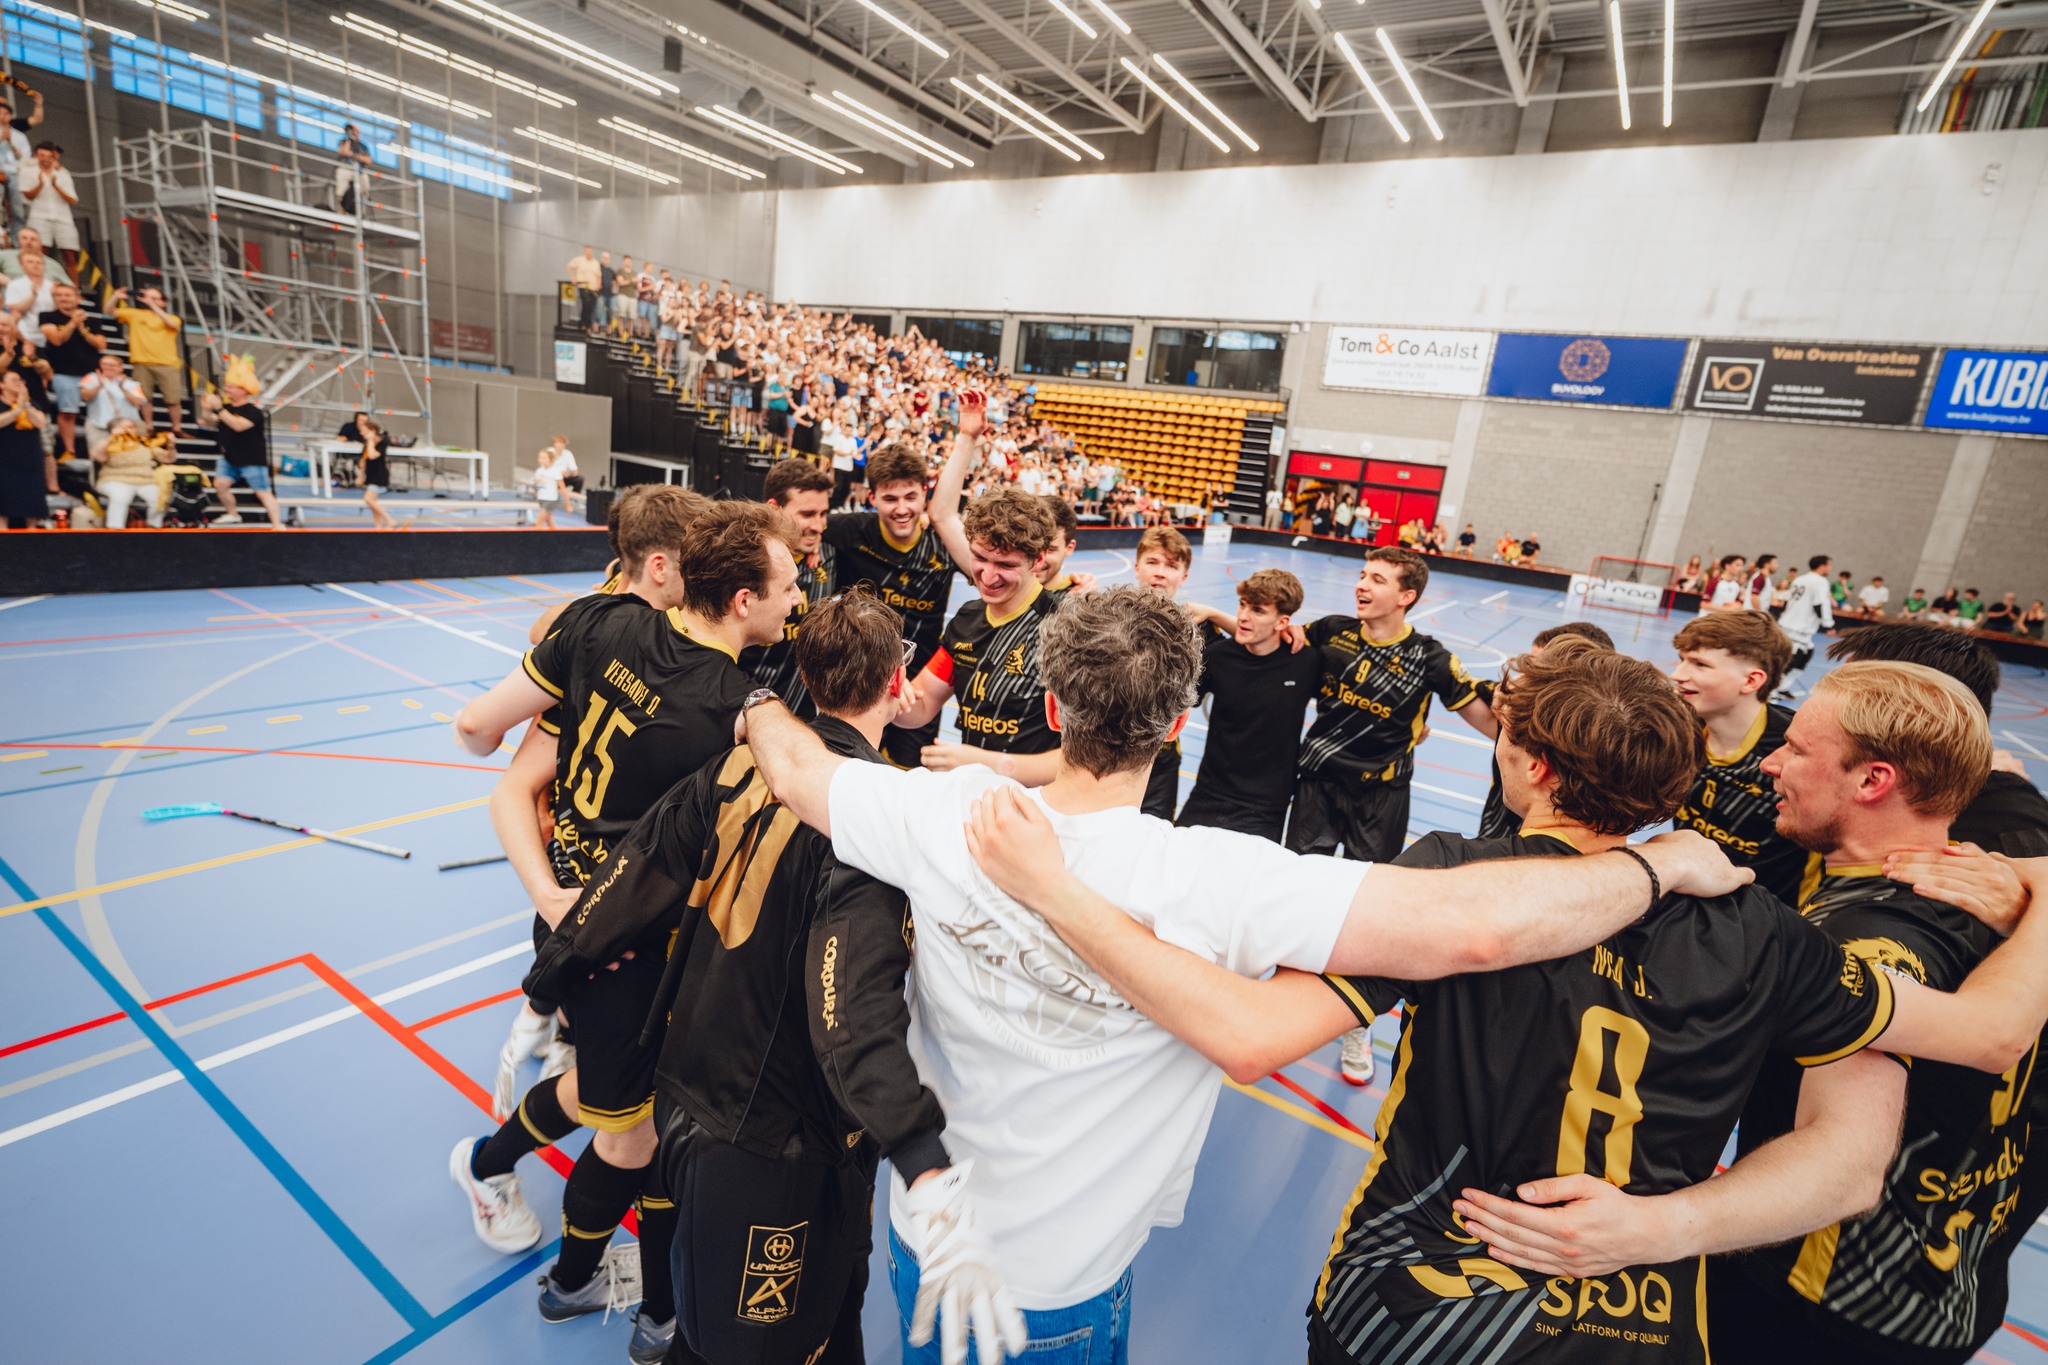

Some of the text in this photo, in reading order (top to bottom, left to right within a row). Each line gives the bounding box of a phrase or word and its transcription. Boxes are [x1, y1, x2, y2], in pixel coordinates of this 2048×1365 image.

[1340, 333, 1480, 360] Tom & Co Aalst
[1772, 346, 1921, 366] Van Overstraeten
[1711, 364, 1753, 391] VO
[1855, 365, 1917, 377] Interieurs
[881, 588, 936, 611] Tereos
[603, 658, 650, 708] VERSAVEL
[1354, 659, 1372, 684] 9
[972, 671, 989, 702] 14
[1337, 682, 1393, 719] Tereos
[961, 705, 1020, 735] Tereos
[563, 690, 638, 821] 15
[576, 855, 629, 926] CORDURA
[820, 935, 838, 1031] CORDURA
[1634, 964, 1653, 1000] J.
[1057, 1053, 1072, 1067] IN
[747, 1306, 789, 1315] ALPHA
[1623, 1330, 1638, 1342] OF
